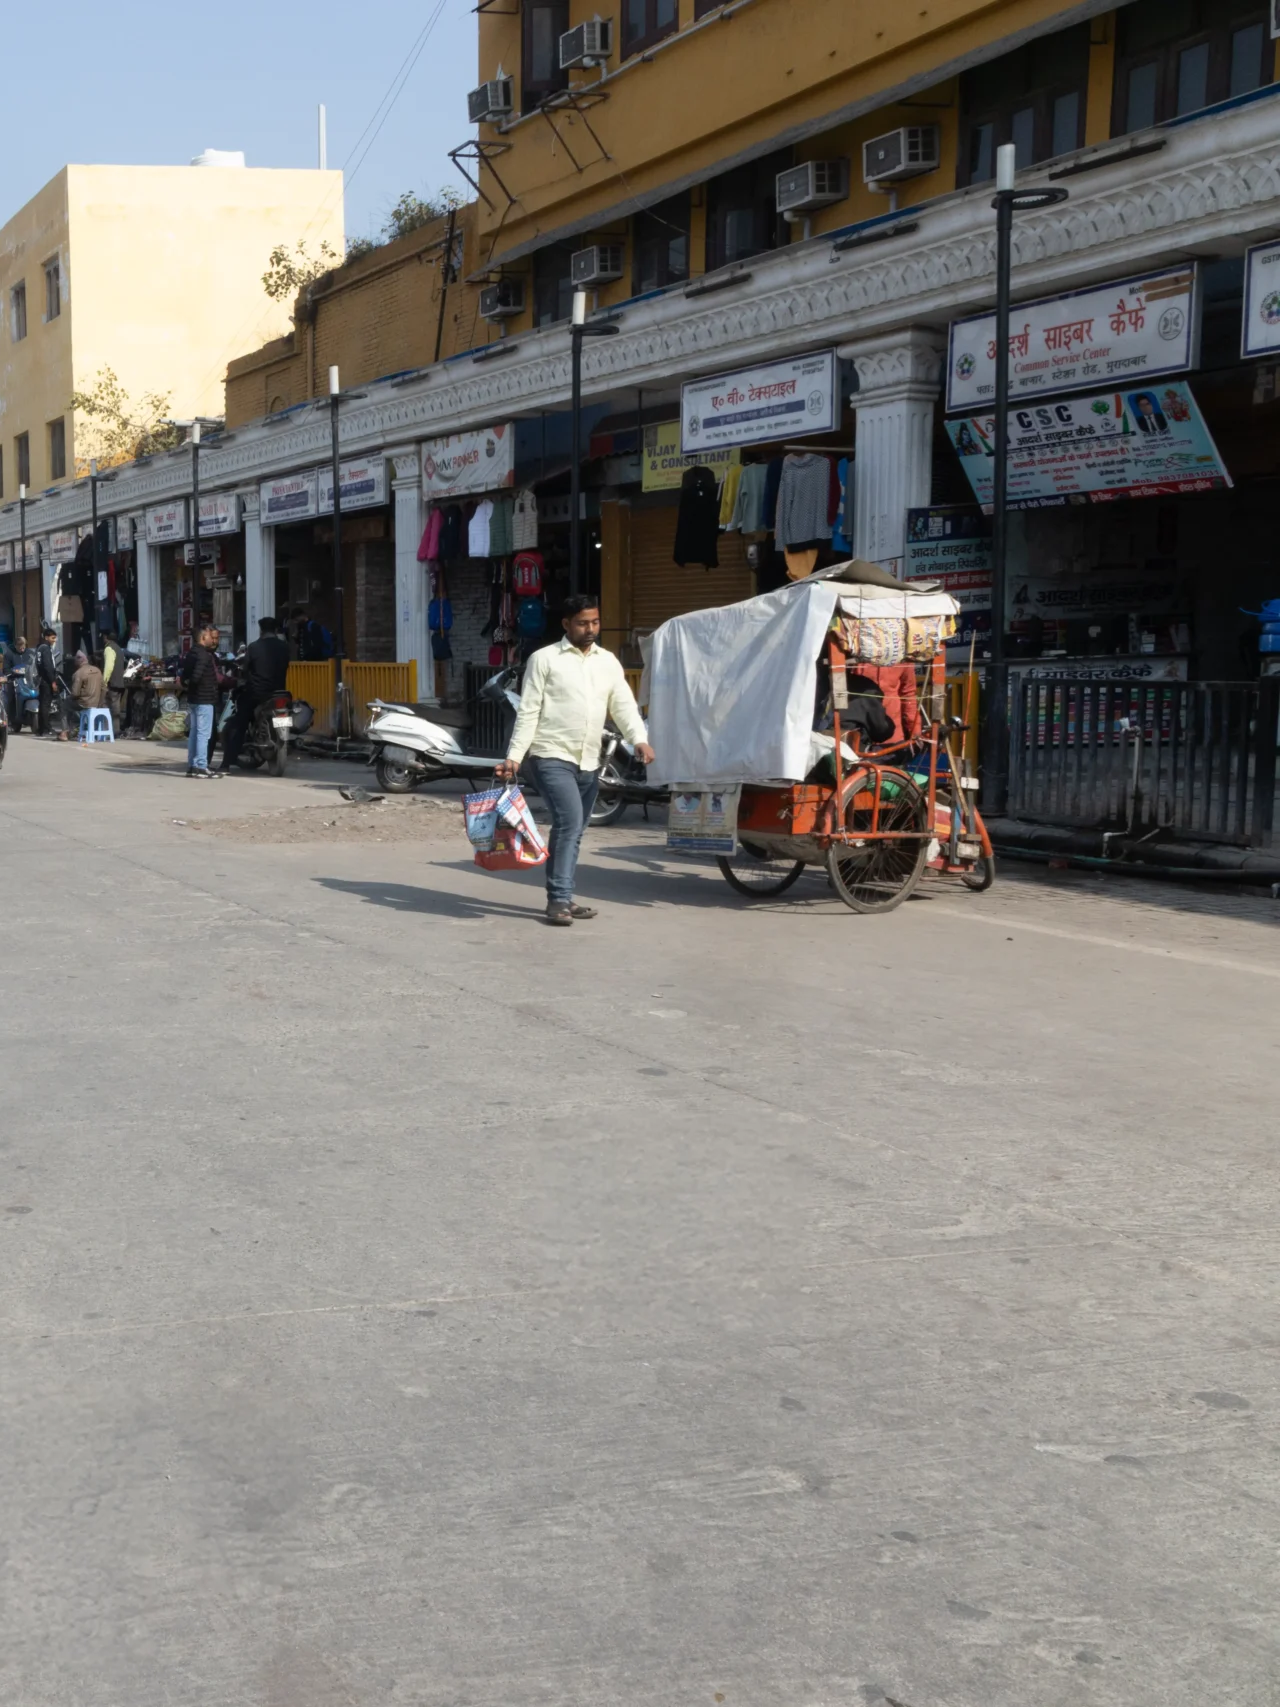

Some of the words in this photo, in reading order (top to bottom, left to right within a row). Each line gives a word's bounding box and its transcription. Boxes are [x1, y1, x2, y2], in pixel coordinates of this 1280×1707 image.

[1043, 318, 1095, 351] साइबर
[1108, 297, 1147, 336] कैफे
[1014, 358, 1050, 375] Common
[1051, 351, 1081, 370] Service
[1083, 345, 1112, 363] Center
[1106, 353, 1148, 374] मुरादाबाद
[748, 379, 797, 403] टेक्सटाइल
[1015, 404, 1073, 429] CSC
[1016, 432, 1043, 446] आदर्श
[1044, 429, 1074, 443] साइबर
[1075, 424, 1097, 438] कैफे
[647, 443, 677, 459] VIJAY
[650, 460, 658, 471] &
[661, 449, 732, 469] CONSULTANT
[1131, 477, 1156, 485] Mob.
[910, 543, 939, 559] आदर्श
[942, 541, 973, 557] साइबर
